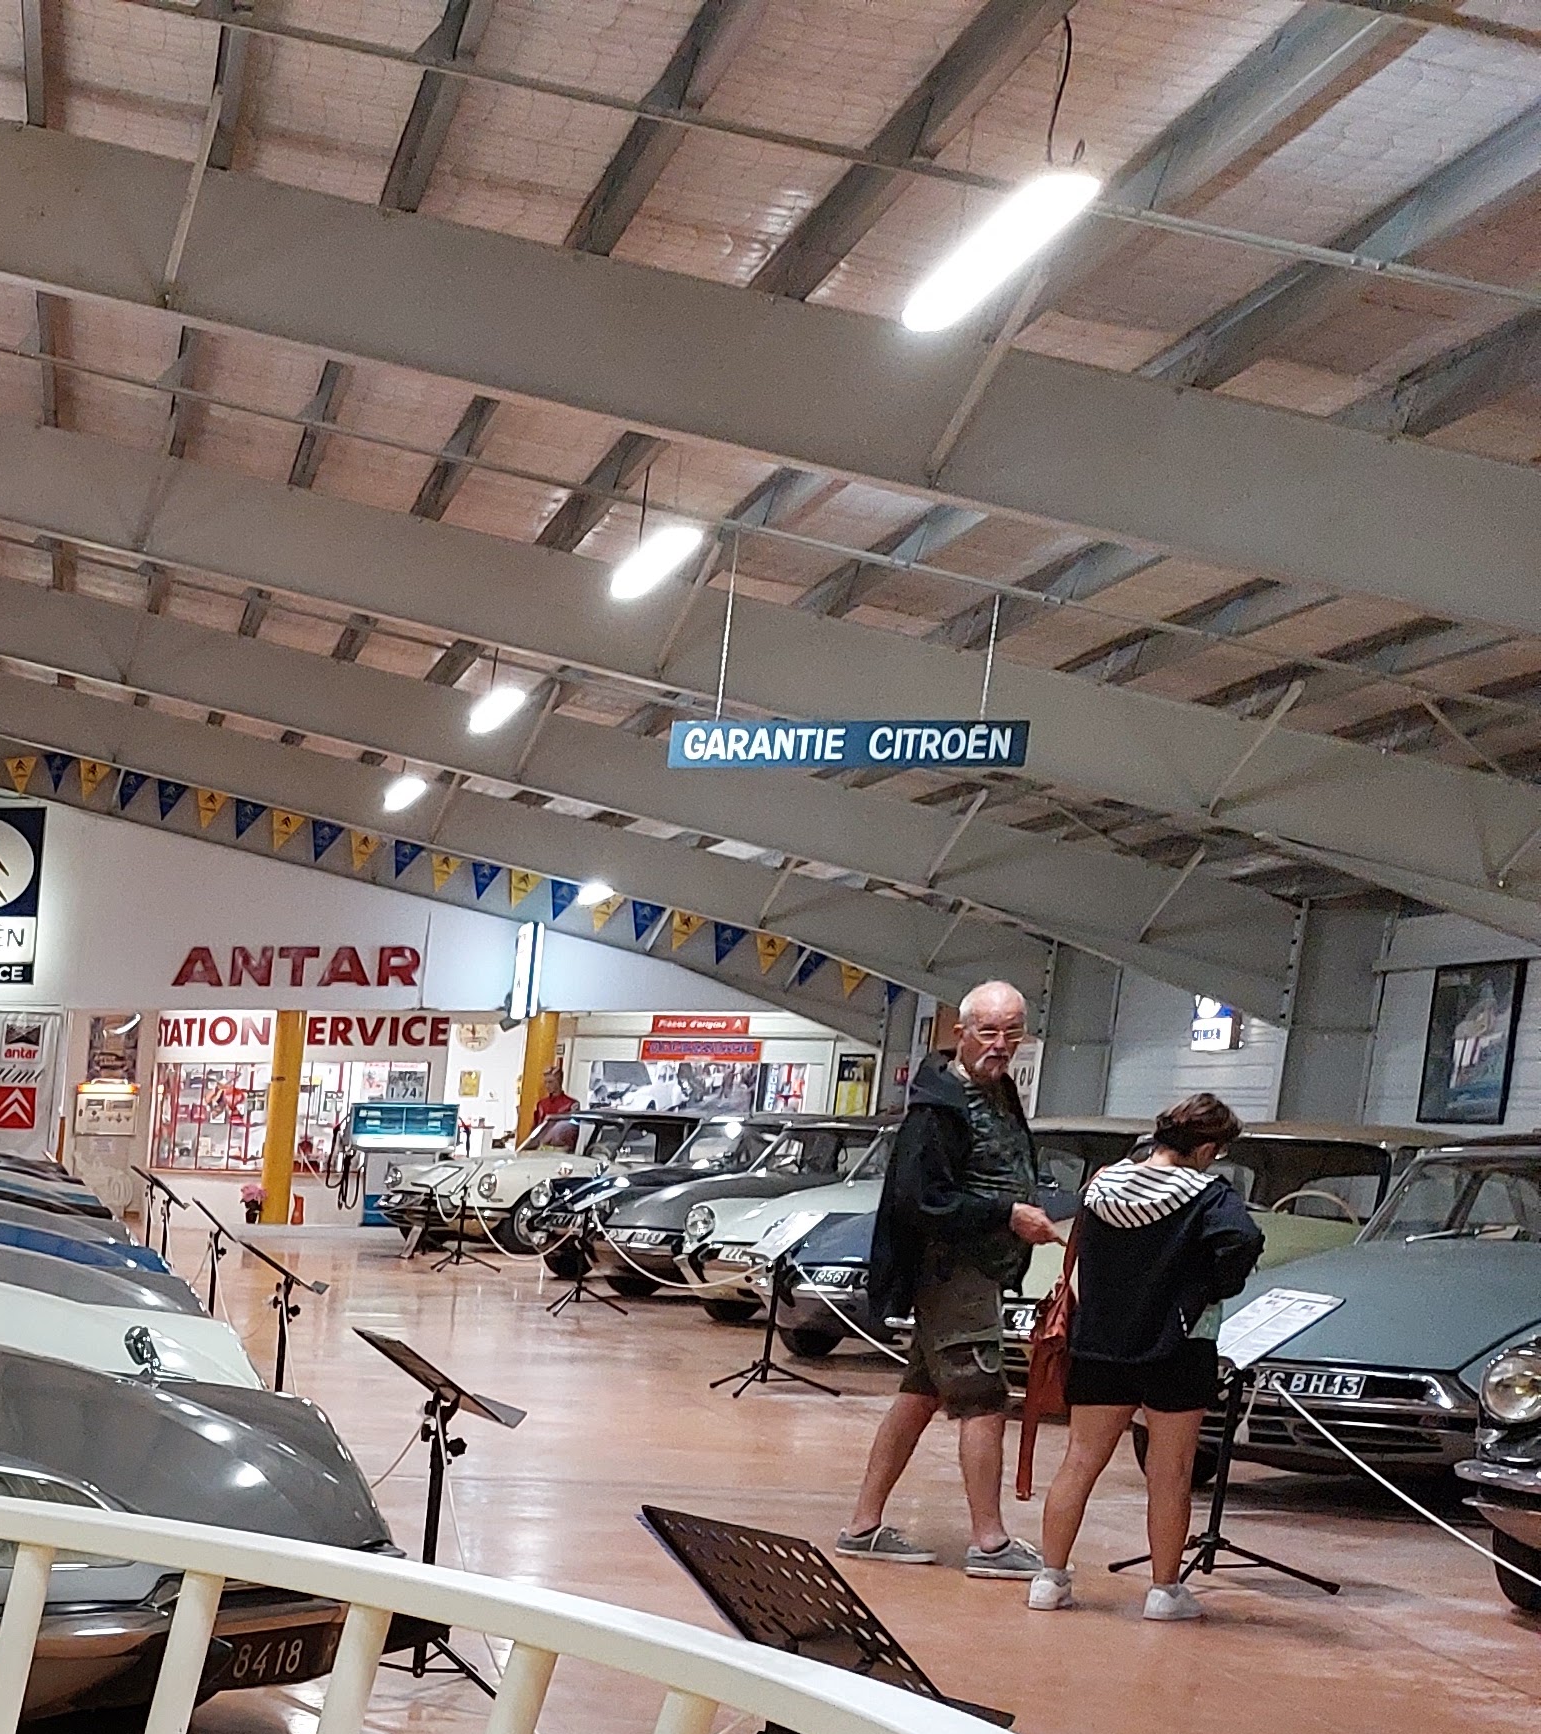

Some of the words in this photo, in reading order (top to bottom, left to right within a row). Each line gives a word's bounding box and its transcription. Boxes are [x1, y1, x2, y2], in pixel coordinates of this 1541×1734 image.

[683, 727, 846, 761] GARANTIE
[171, 946, 421, 987] ANTAR
[306, 1016, 450, 1047] ERVICE
[4, 1047, 39, 1060] antar
[232, 1638, 304, 1679] 8418
